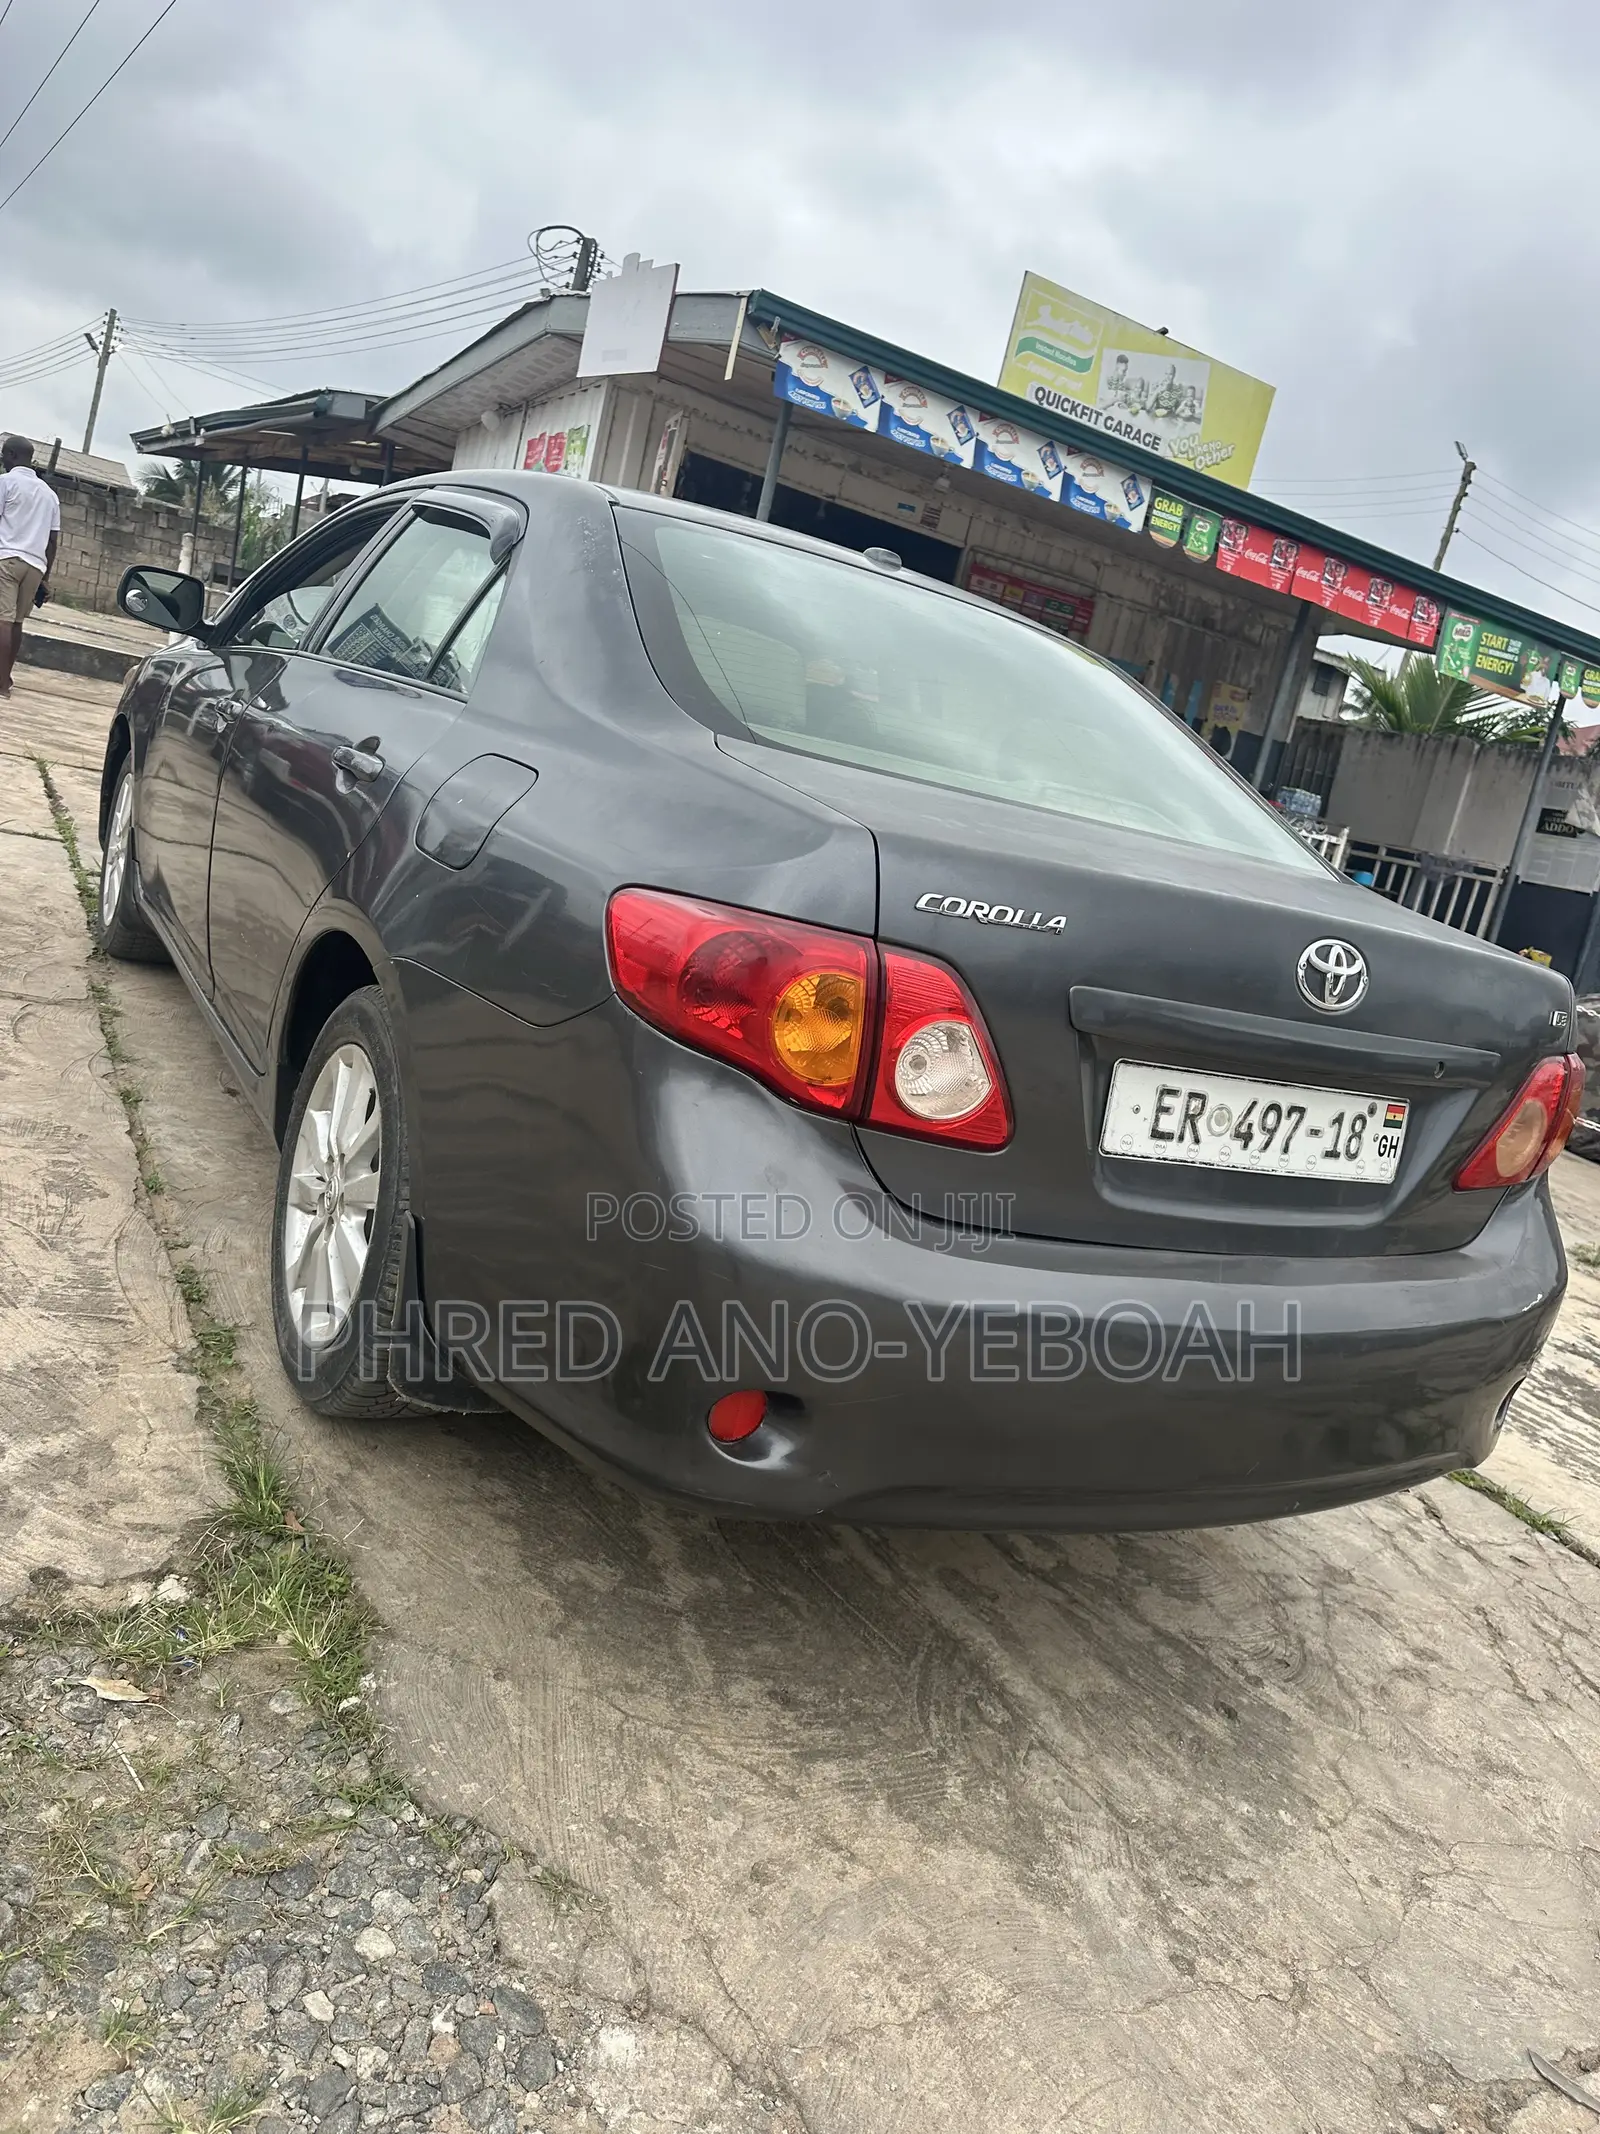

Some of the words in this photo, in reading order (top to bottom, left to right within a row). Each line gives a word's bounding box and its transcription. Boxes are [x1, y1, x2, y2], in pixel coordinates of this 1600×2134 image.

[1035, 386, 1103, 425] QUICKFIT
[1103, 416, 1161, 452] GARAGE
[1194, 444, 1236, 472] Other
[1154, 497, 1184, 516] GRAB
[1151, 516, 1180, 532] ENERGY!
[1480, 632, 1509, 650] START
[1475, 654, 1515, 675] ENERGY!
[1541, 821, 1575, 833] ADDO
[915, 892, 1067, 935] COROLLA
[1149, 1084, 1209, 1145] ER
[1231, 1098, 1368, 1161] 497-18
[1377, 1134, 1399, 1159] GH
